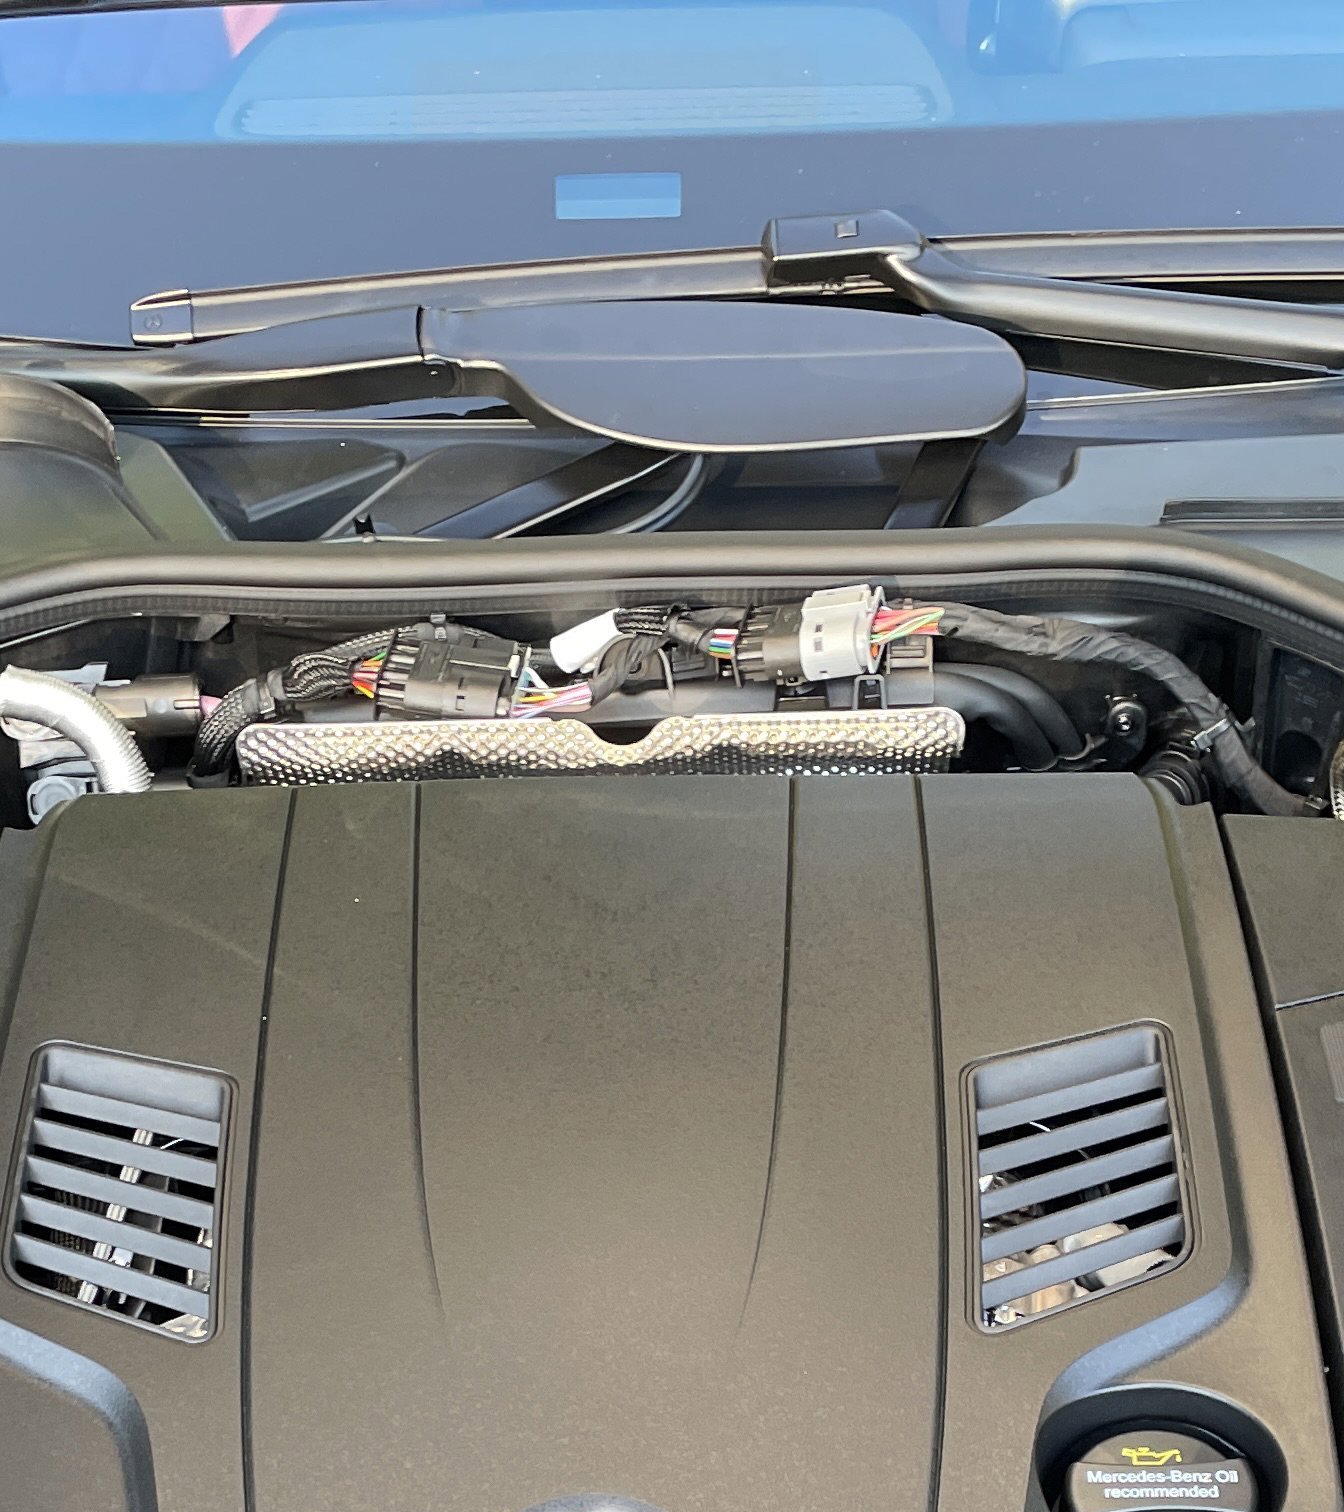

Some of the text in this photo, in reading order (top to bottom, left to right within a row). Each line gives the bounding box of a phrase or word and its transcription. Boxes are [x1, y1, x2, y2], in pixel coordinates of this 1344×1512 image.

[1086, 1470, 1239, 1483] Mercedes-Benz Oil
[1104, 1485, 1220, 1499] recommended
